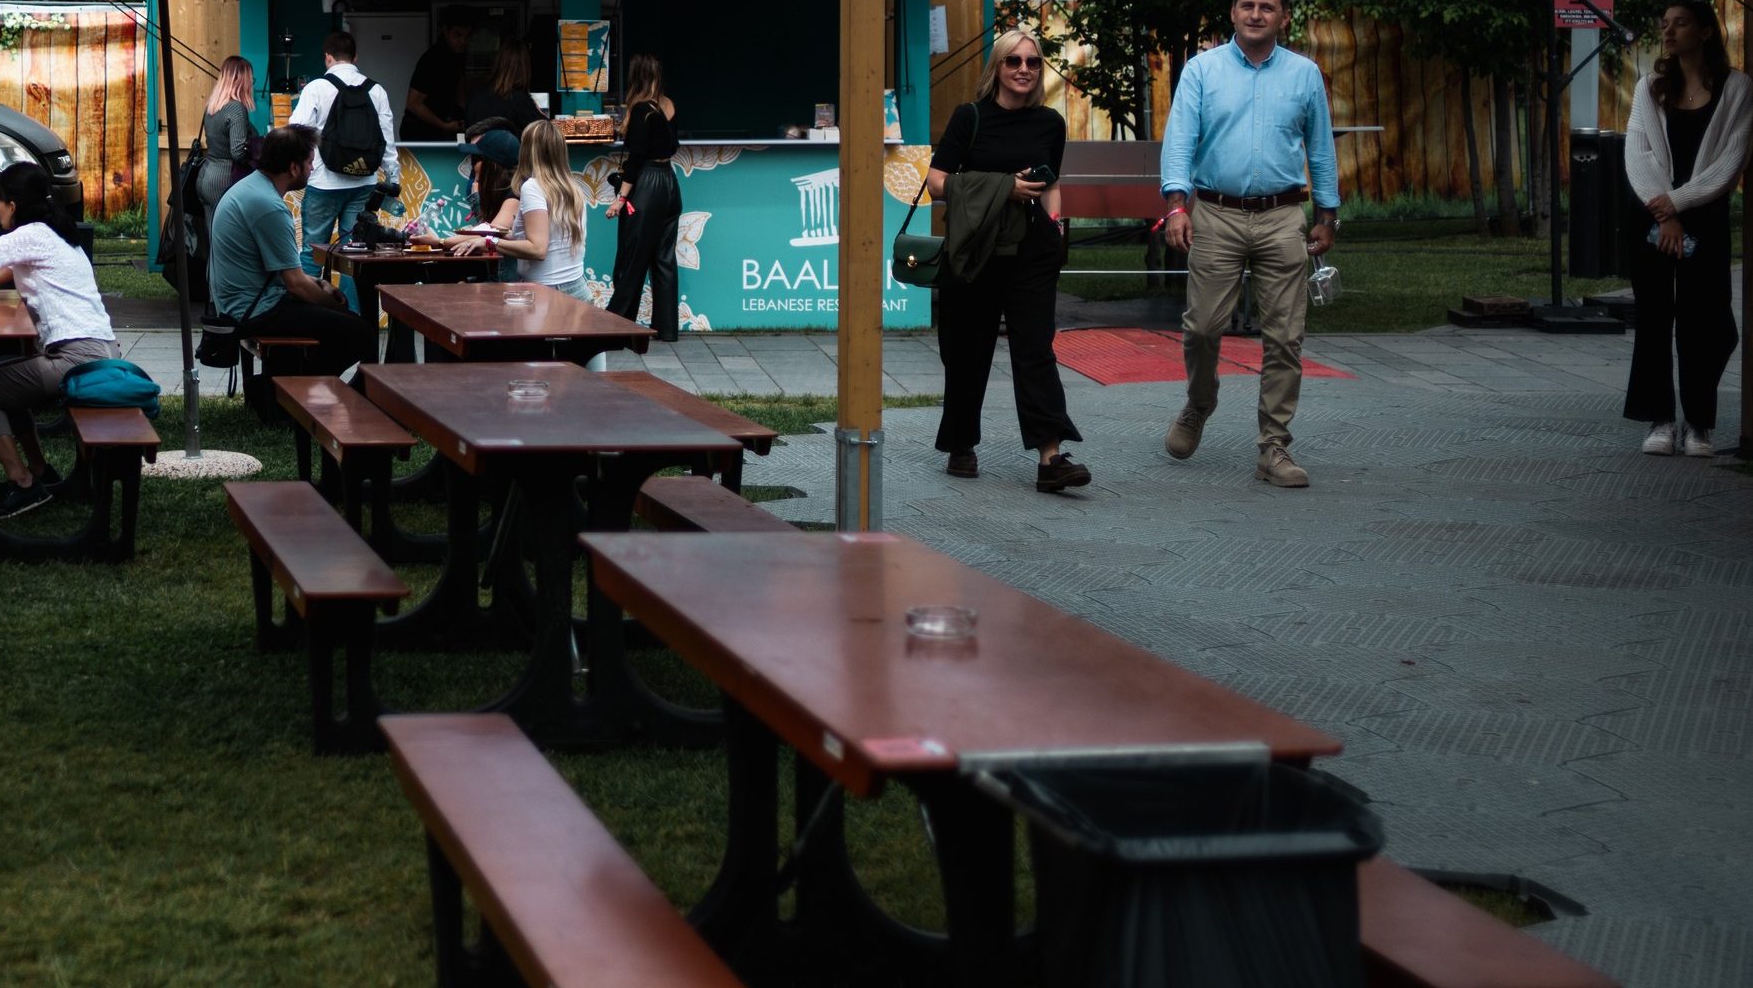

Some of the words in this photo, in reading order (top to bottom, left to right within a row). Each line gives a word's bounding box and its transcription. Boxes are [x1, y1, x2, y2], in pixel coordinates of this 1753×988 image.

[742, 259, 908, 290] BAALK
[742, 298, 813, 311] LEBANESE
[817, 298, 908, 311] RESANT
